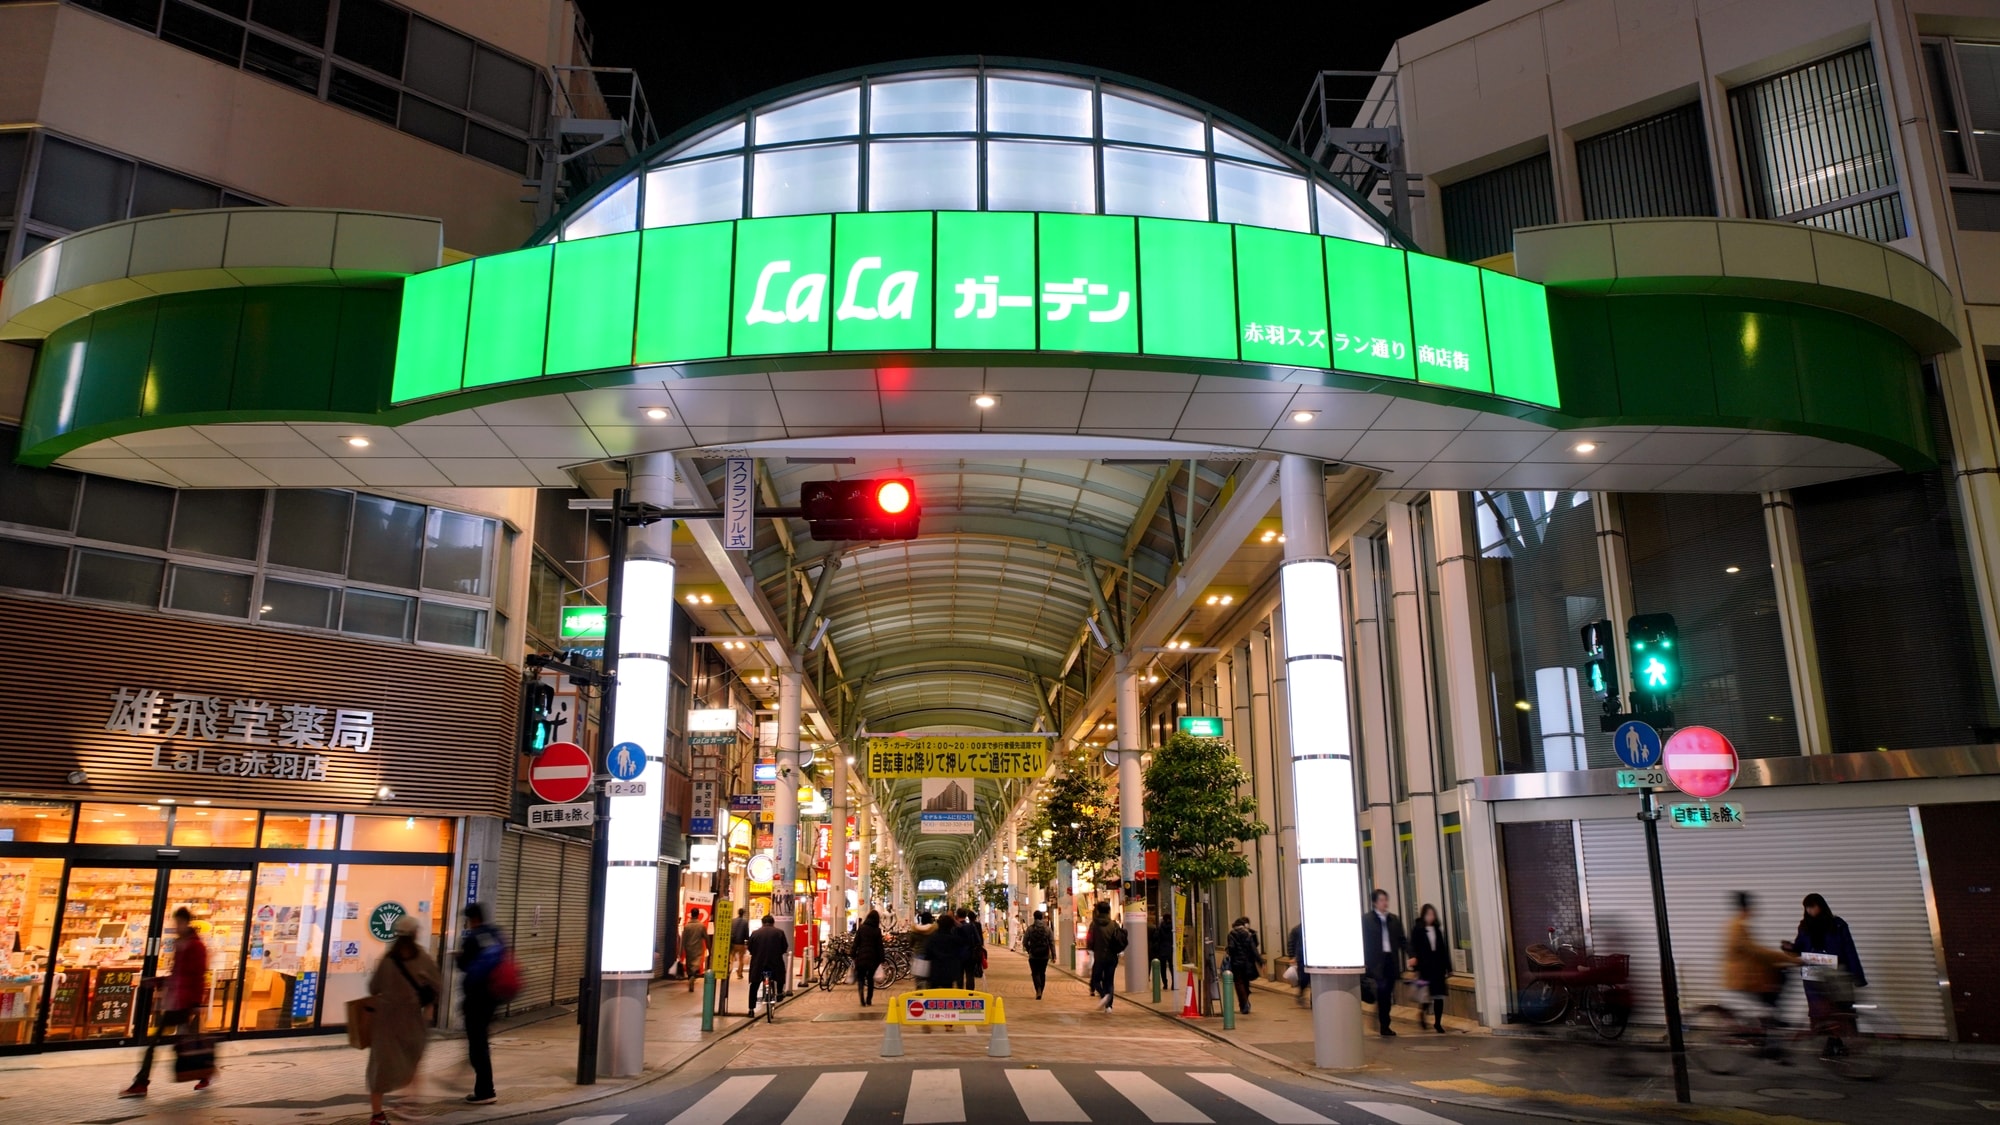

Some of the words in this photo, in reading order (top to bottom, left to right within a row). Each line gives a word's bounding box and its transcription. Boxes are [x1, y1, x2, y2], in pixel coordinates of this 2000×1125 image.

[954, 275, 1130, 323] ガーデン
[105, 686, 374, 753] 雄飛堂薬局
[151, 745, 329, 781] LaLa赤羽店
[873, 752, 1042, 774] 自転車は降りて押してご通行下さい
[608, 784, 644, 794] 12-20
[1621, 773, 1663, 785] 12-20
[531, 807, 591, 825] 自転車を除く
[1674, 806, 1742, 823] 自転車を除く
